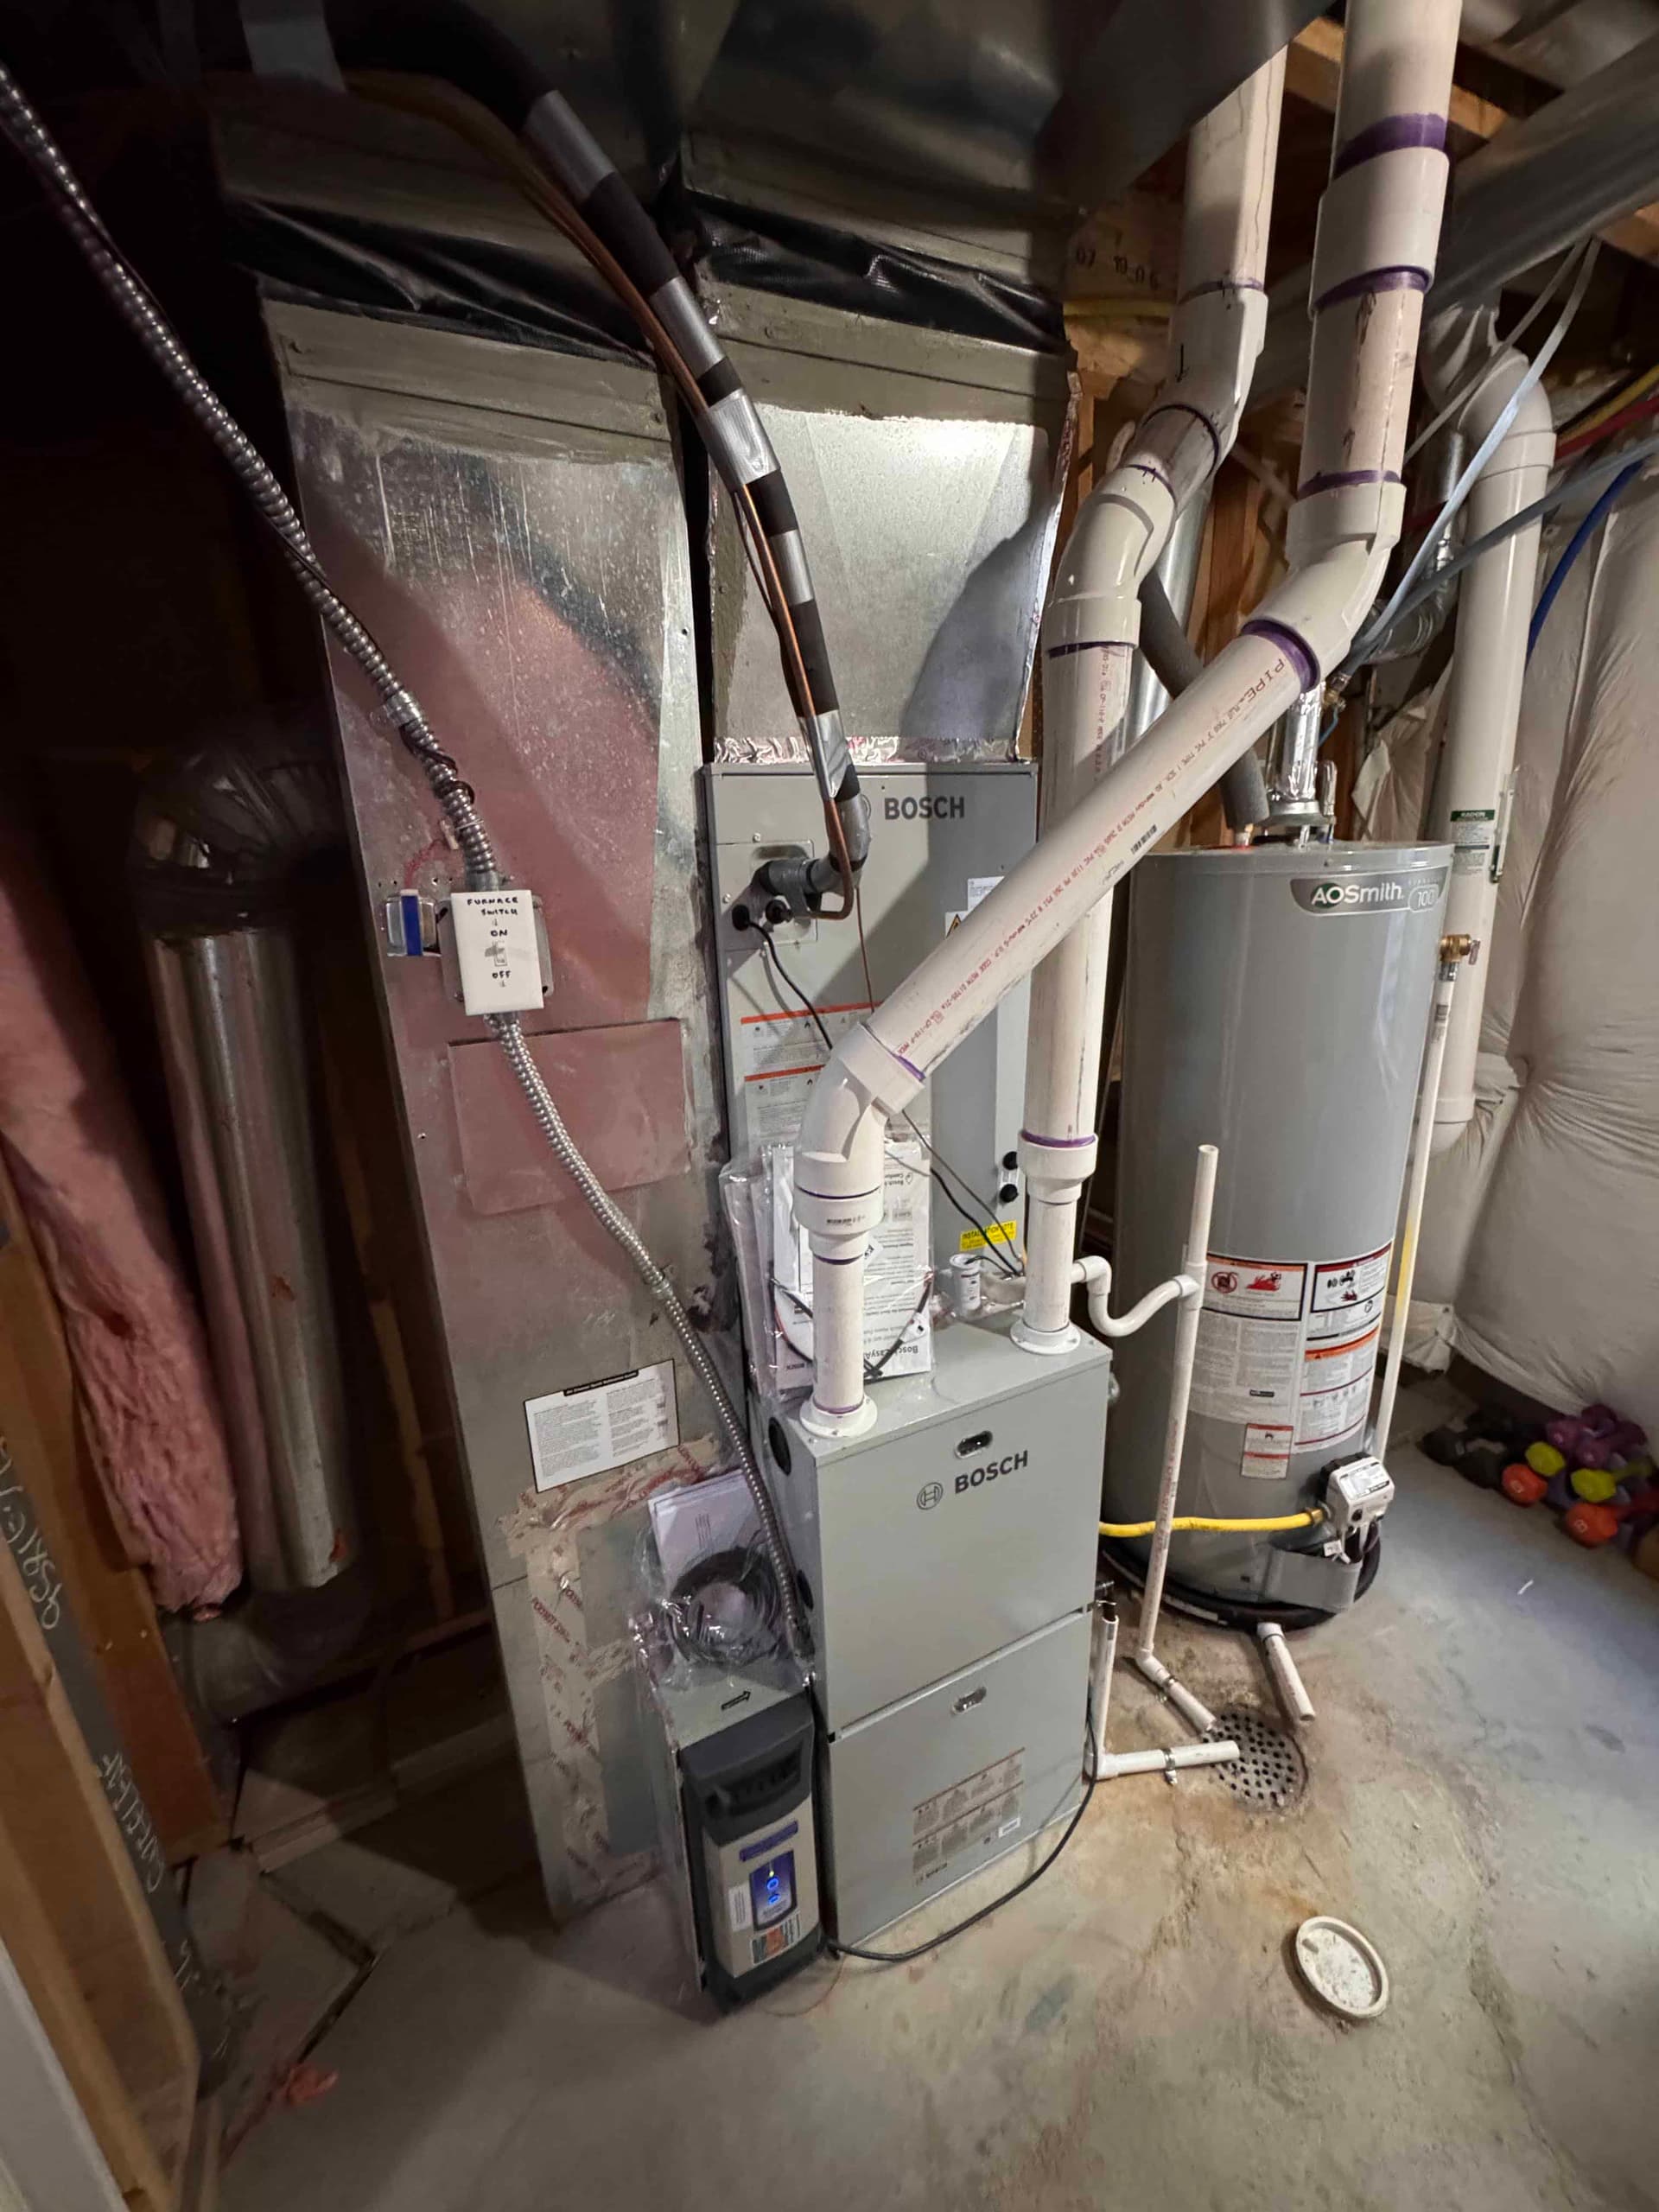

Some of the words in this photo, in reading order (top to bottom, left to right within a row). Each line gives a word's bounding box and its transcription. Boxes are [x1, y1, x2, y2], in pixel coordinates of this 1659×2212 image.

[1242, 657, 1287, 702] PIPE
[884, 796, 965, 820] BOSCH
[467, 897, 518, 906] FURNACE
[492, 970, 512, 979] OFF
[955, 1450, 1029, 1494] BOSCH
